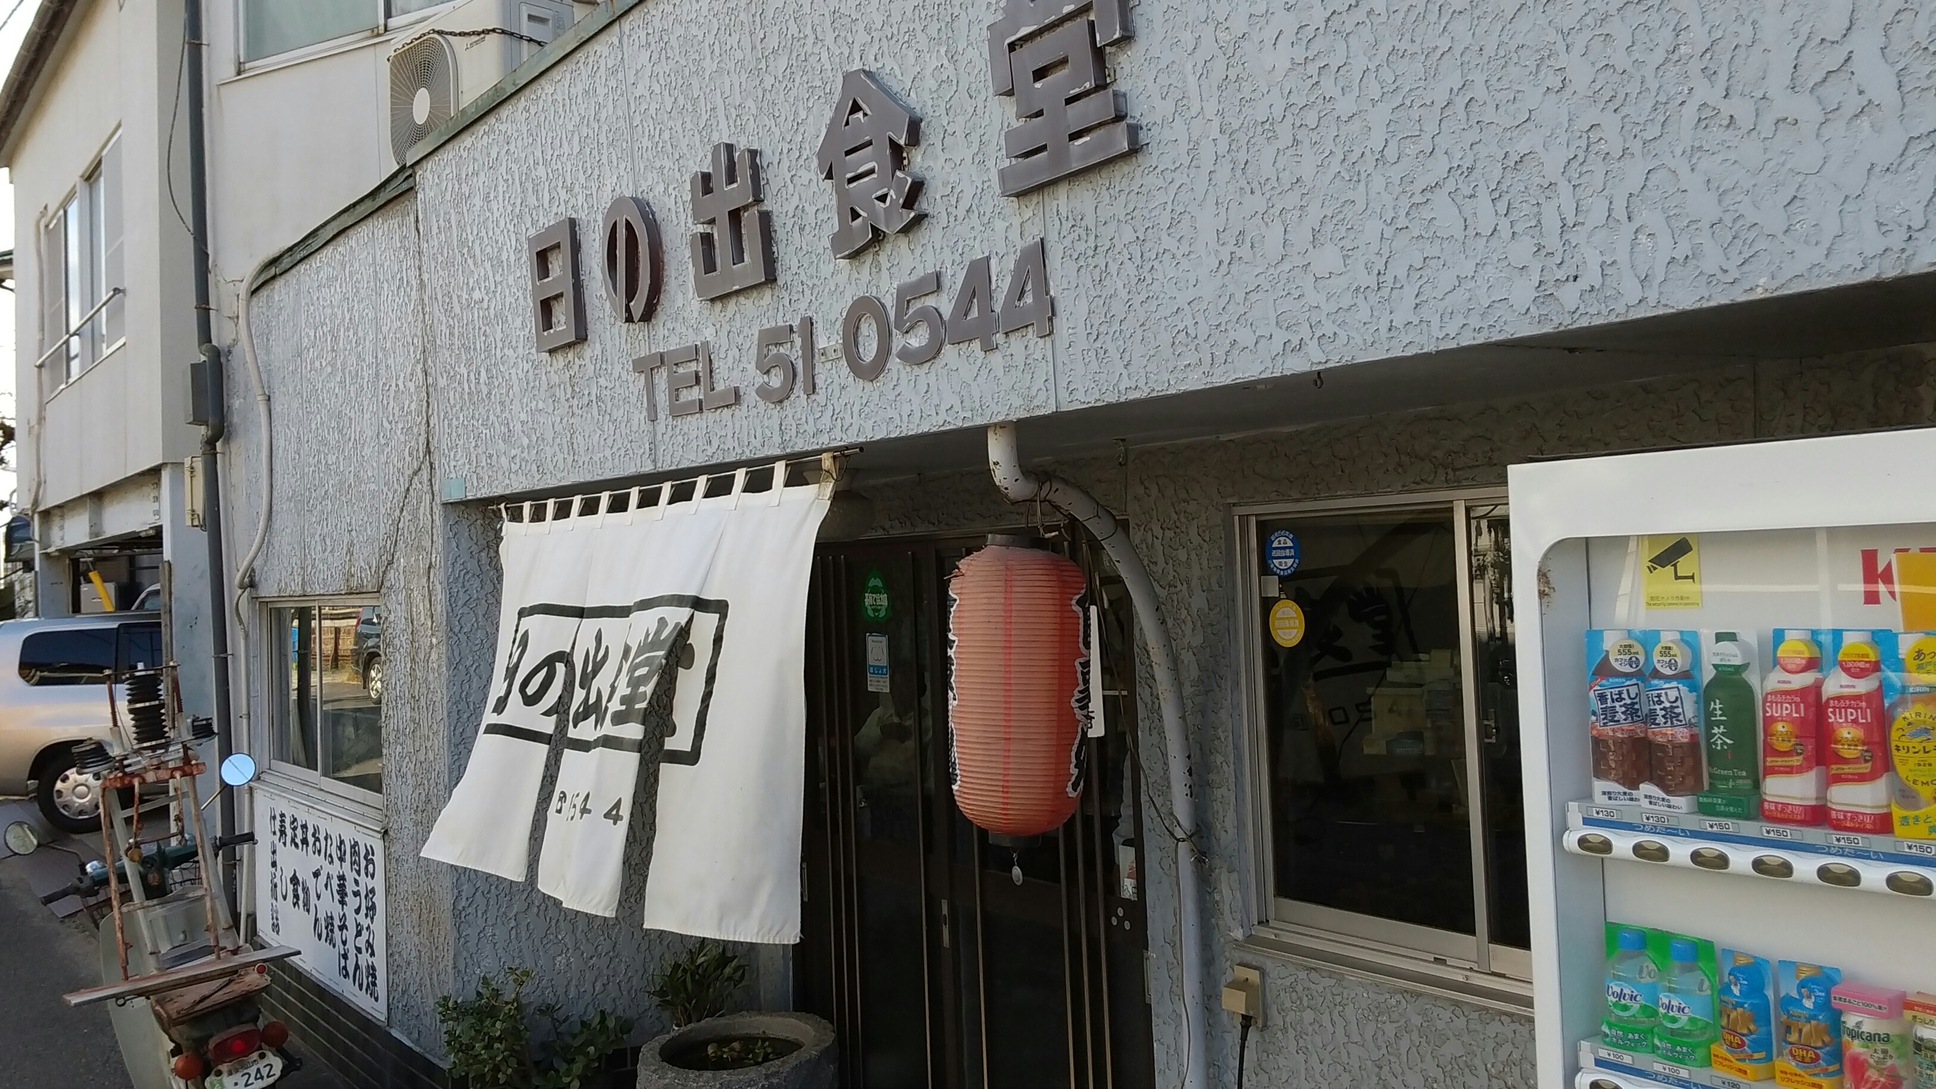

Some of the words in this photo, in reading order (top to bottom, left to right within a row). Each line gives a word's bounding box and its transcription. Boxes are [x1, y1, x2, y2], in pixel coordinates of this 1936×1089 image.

[632, 340, 739, 421] TEL
[1597, 688, 1639, 706] 香ばし
[1600, 702, 1640, 726] 麦茶
[1765, 702, 1805, 717] SUPLI
[1827, 708, 1871, 723] SUPLI
[1709, 698, 1735, 750] 生茶
[1594, 808, 1615, 818] ¥130
[1644, 814, 1666, 824] ¥130
[1899, 813, 1936, 827] 透きと
[1707, 822, 1731, 831] ¥150
[1765, 827, 1789, 837] ¥150
[1834, 835, 1860, 845] ¥150
[1906, 843, 1933, 855] ¥150
[290, 813, 300, 911] 定食
[312, 823, 323, 942] おでん
[324, 828, 336, 949] なべ焼
[335, 833, 350, 980] 中華そば
[349, 837, 364, 992] 肉うどん
[363, 842, 379, 1003] お好み焼
[1606, 983, 1642, 1003] Volvic
[1607, 1051, 1624, 1061] ¥100
[1662, 1065, 1680, 1075] ¥100
[1721, 1080, 1741, 1089] ¥120
